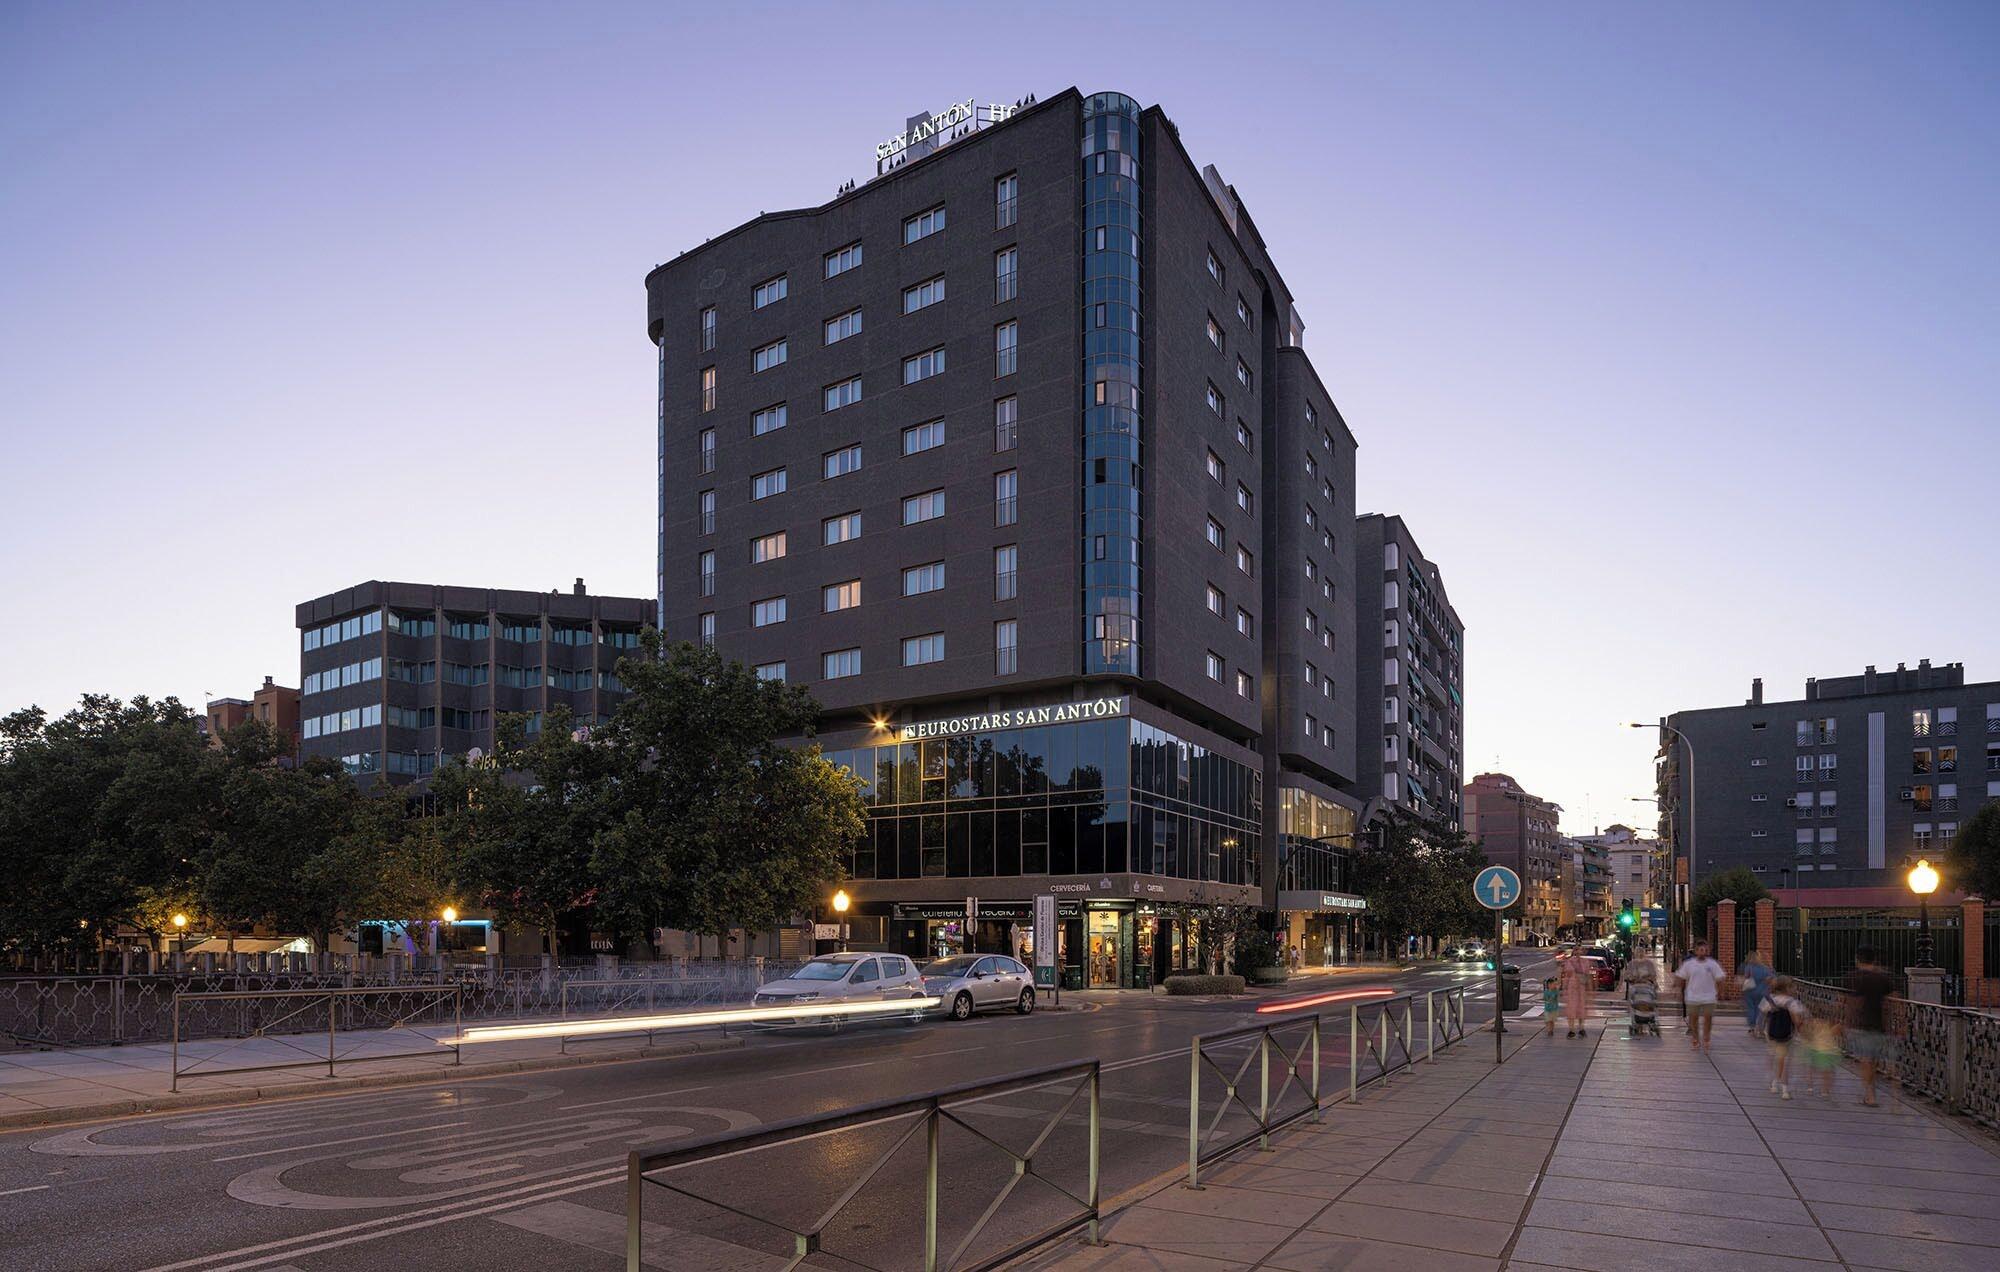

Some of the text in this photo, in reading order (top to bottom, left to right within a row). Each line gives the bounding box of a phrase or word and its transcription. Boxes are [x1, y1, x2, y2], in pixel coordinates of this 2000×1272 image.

[876, 98, 974, 161] SAN ANTÓN
[918, 698, 1122, 737] EUROSTARS SAN ANTÓN
[1050, 883, 1091, 893] CERVECERÍA
